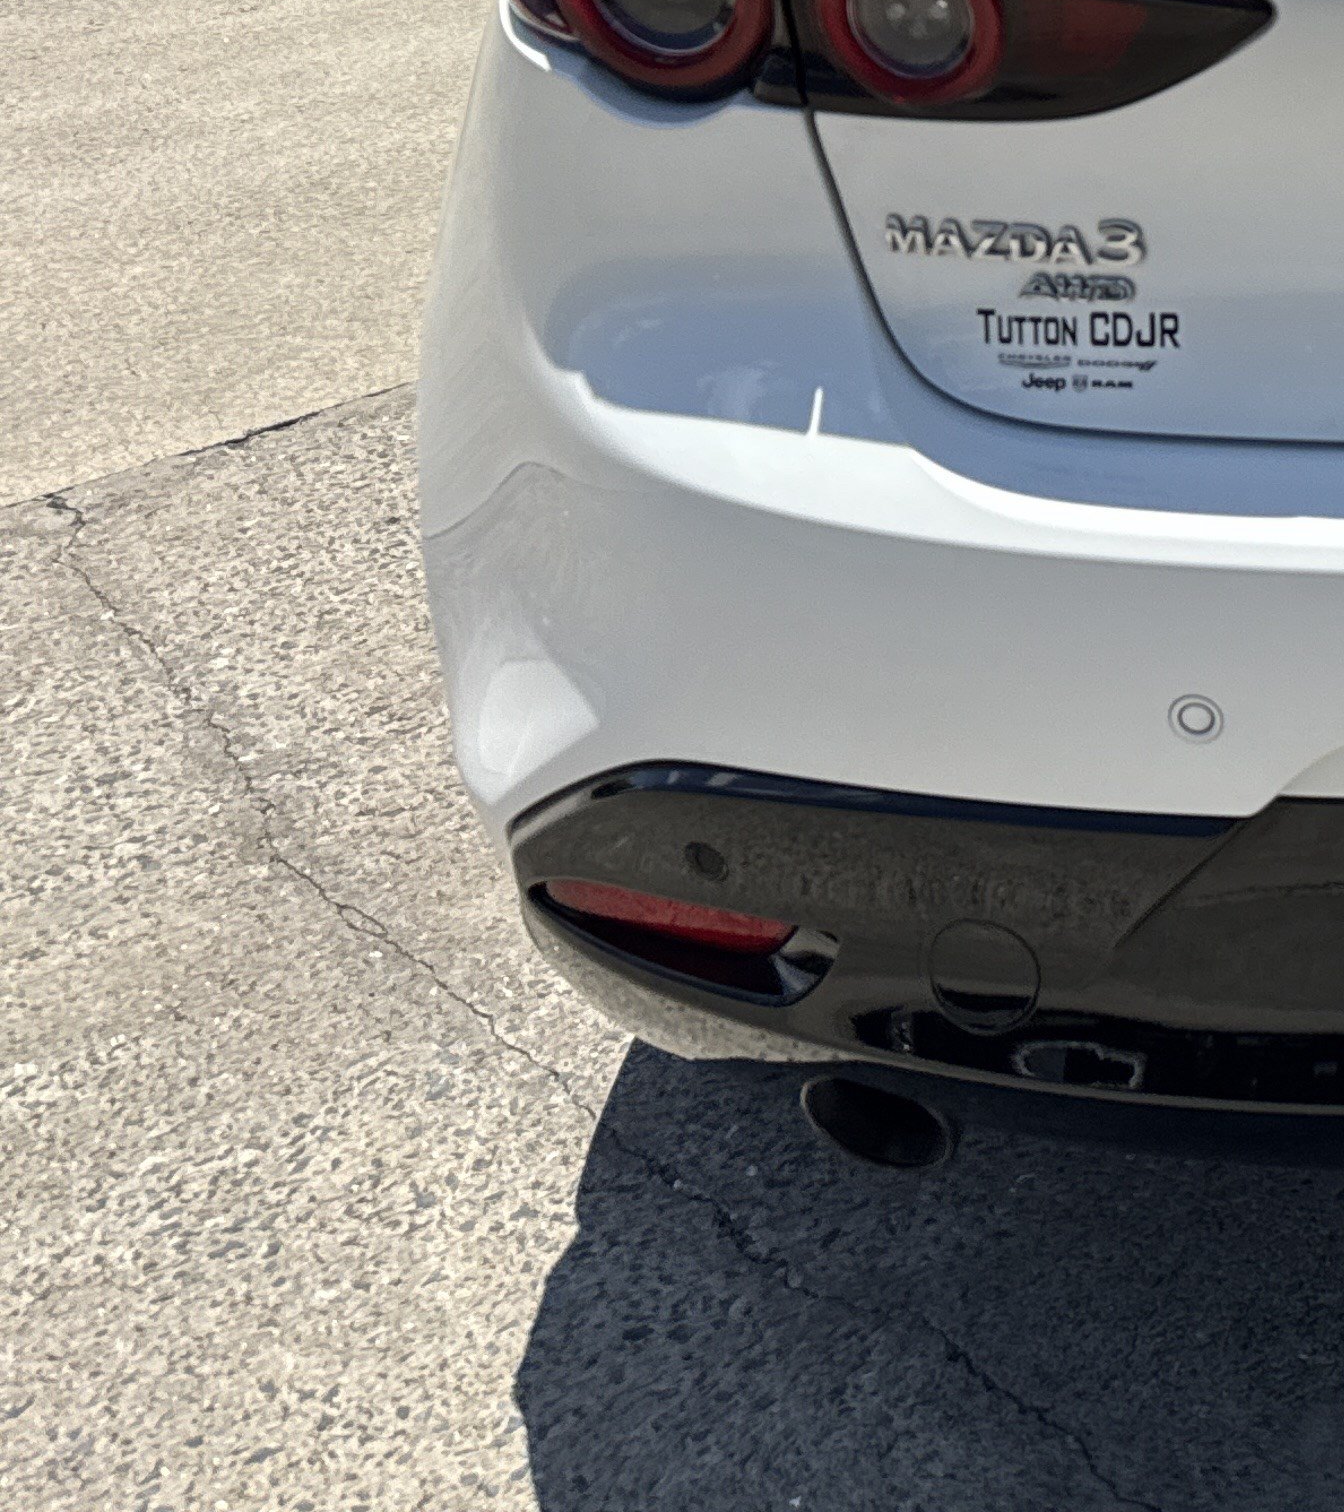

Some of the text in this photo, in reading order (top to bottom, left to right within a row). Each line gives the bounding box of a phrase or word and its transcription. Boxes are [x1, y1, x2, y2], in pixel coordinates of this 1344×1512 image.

[885, 212, 1146, 266] MAZDA3
[1089, 311, 1180, 349] CDJR
[1021, 372, 1067, 392] Jeep
